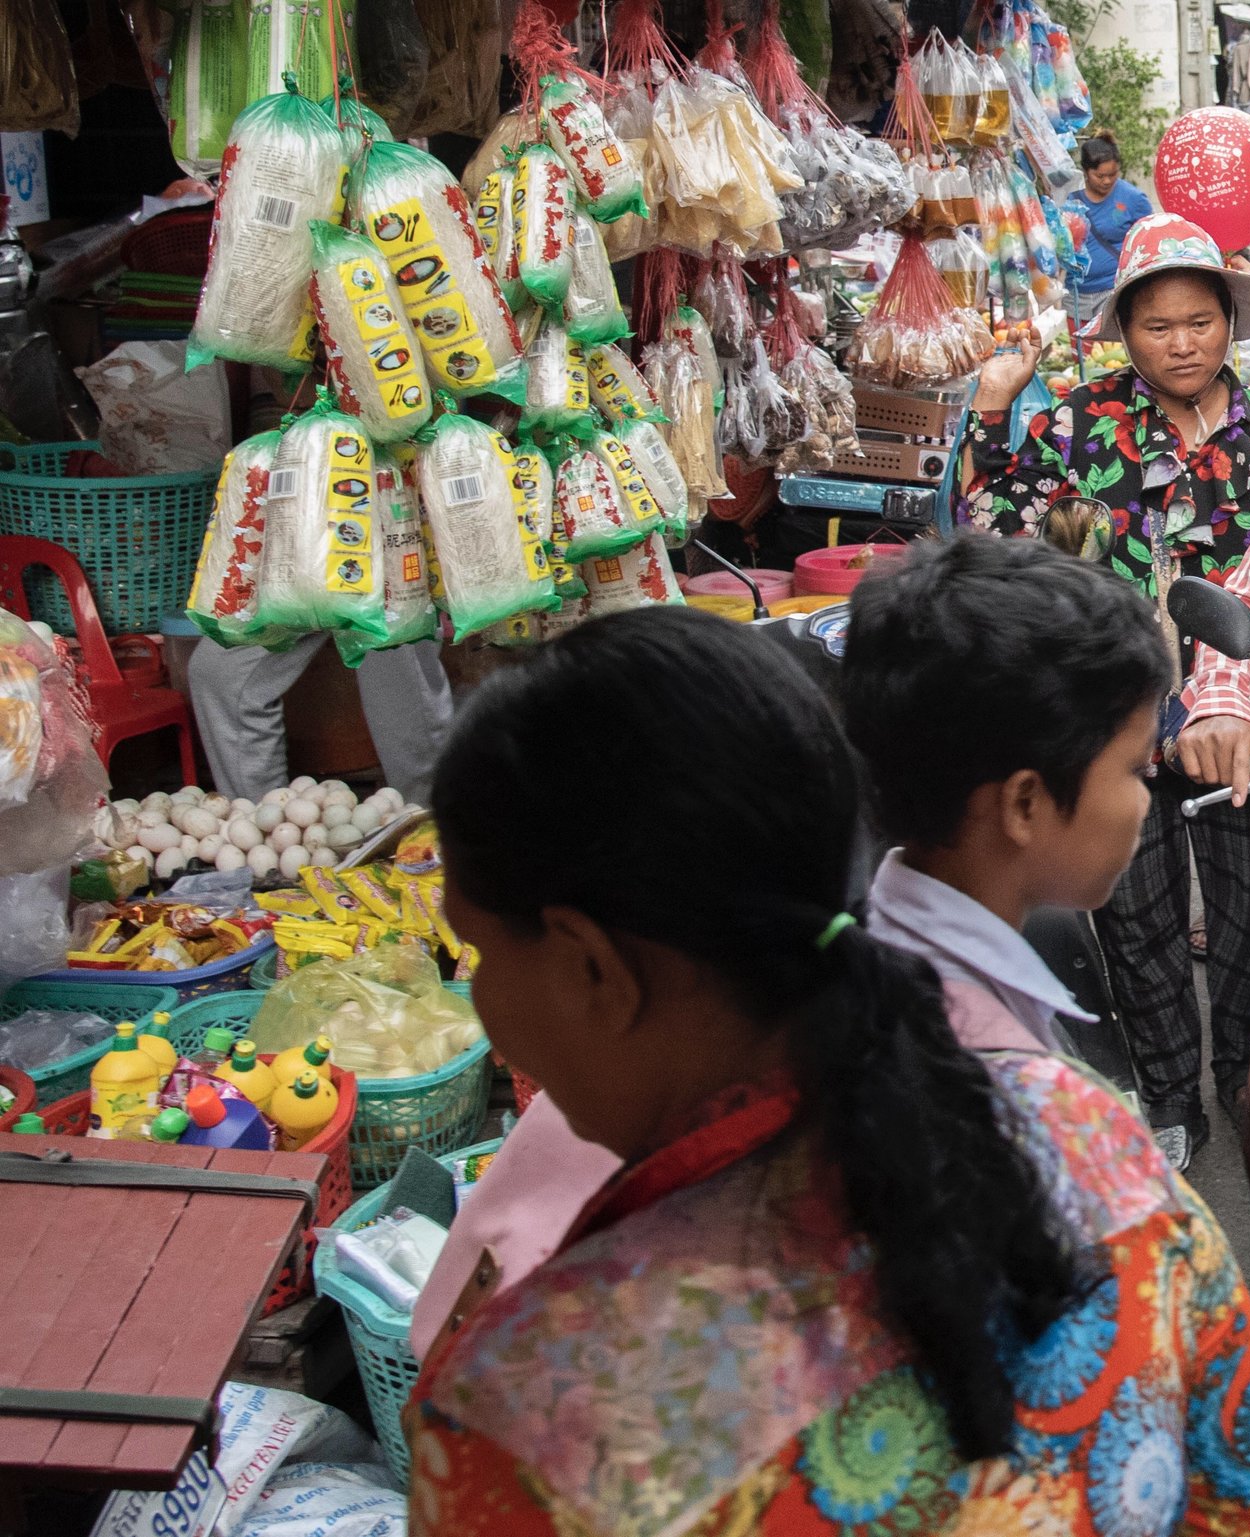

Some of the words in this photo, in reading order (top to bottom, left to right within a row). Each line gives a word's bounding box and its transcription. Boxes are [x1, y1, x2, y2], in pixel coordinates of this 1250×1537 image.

[1167, 166, 1189, 176] HAPPY
[1206, 180, 1231, 193] HAPPY
[1207, 187, 1236, 199] BIRTHDAY
